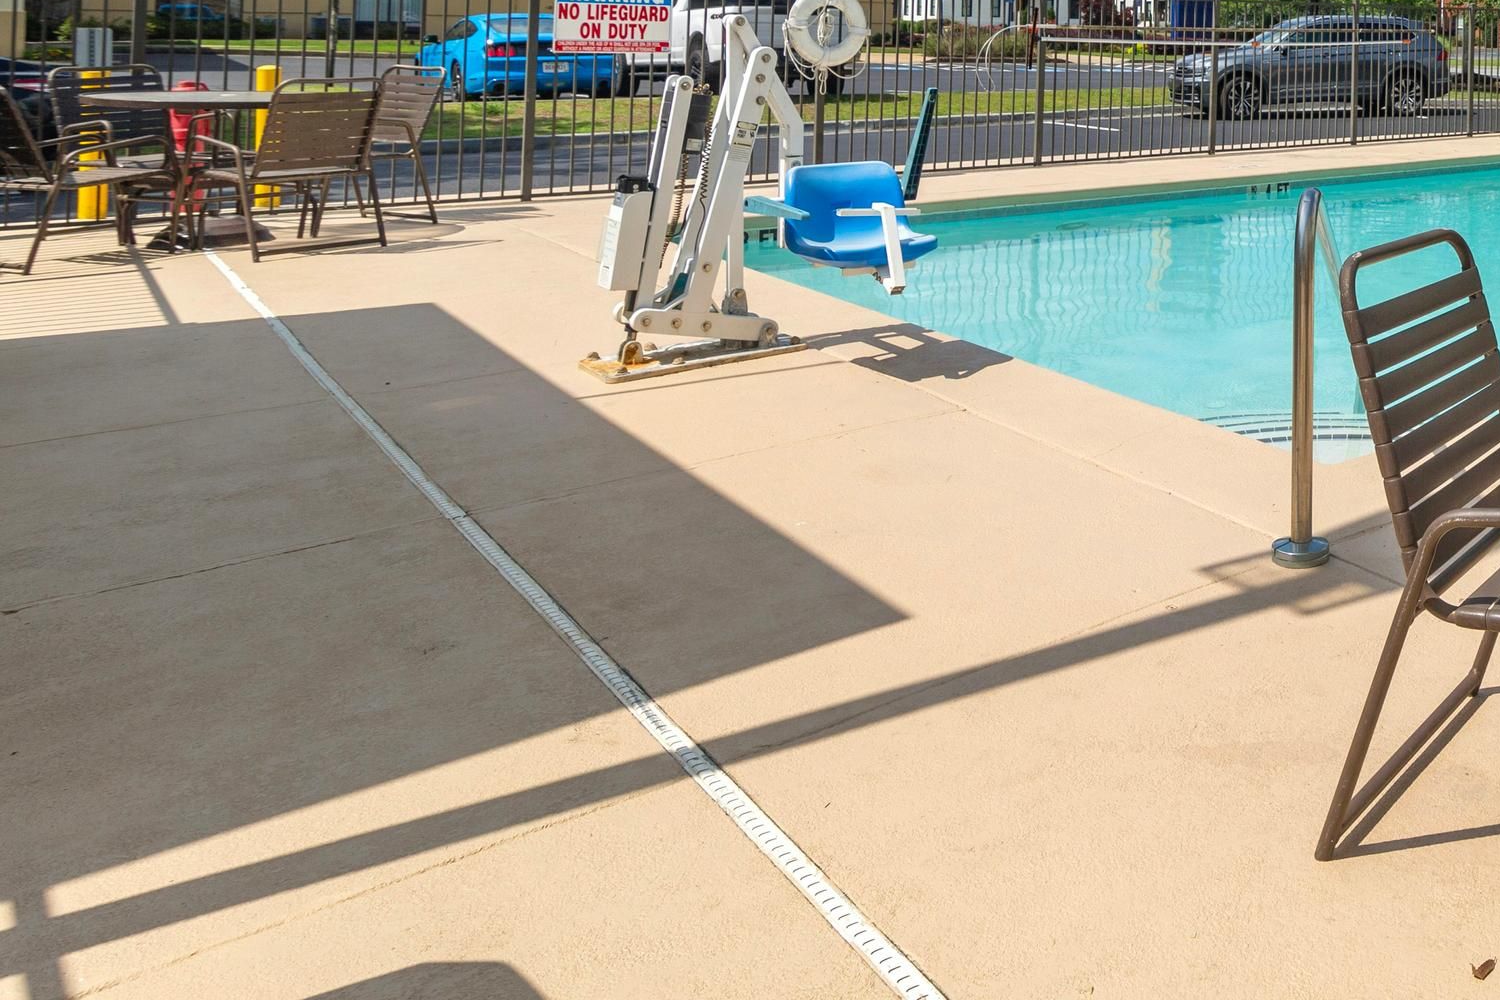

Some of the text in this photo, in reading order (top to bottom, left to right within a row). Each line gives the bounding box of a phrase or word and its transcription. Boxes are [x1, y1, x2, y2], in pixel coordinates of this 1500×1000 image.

[558, 3, 669, 22] NO LIFEGUARD
[580, 22, 648, 40] ON DUTY
[1276, 182, 1289, 192] FT
